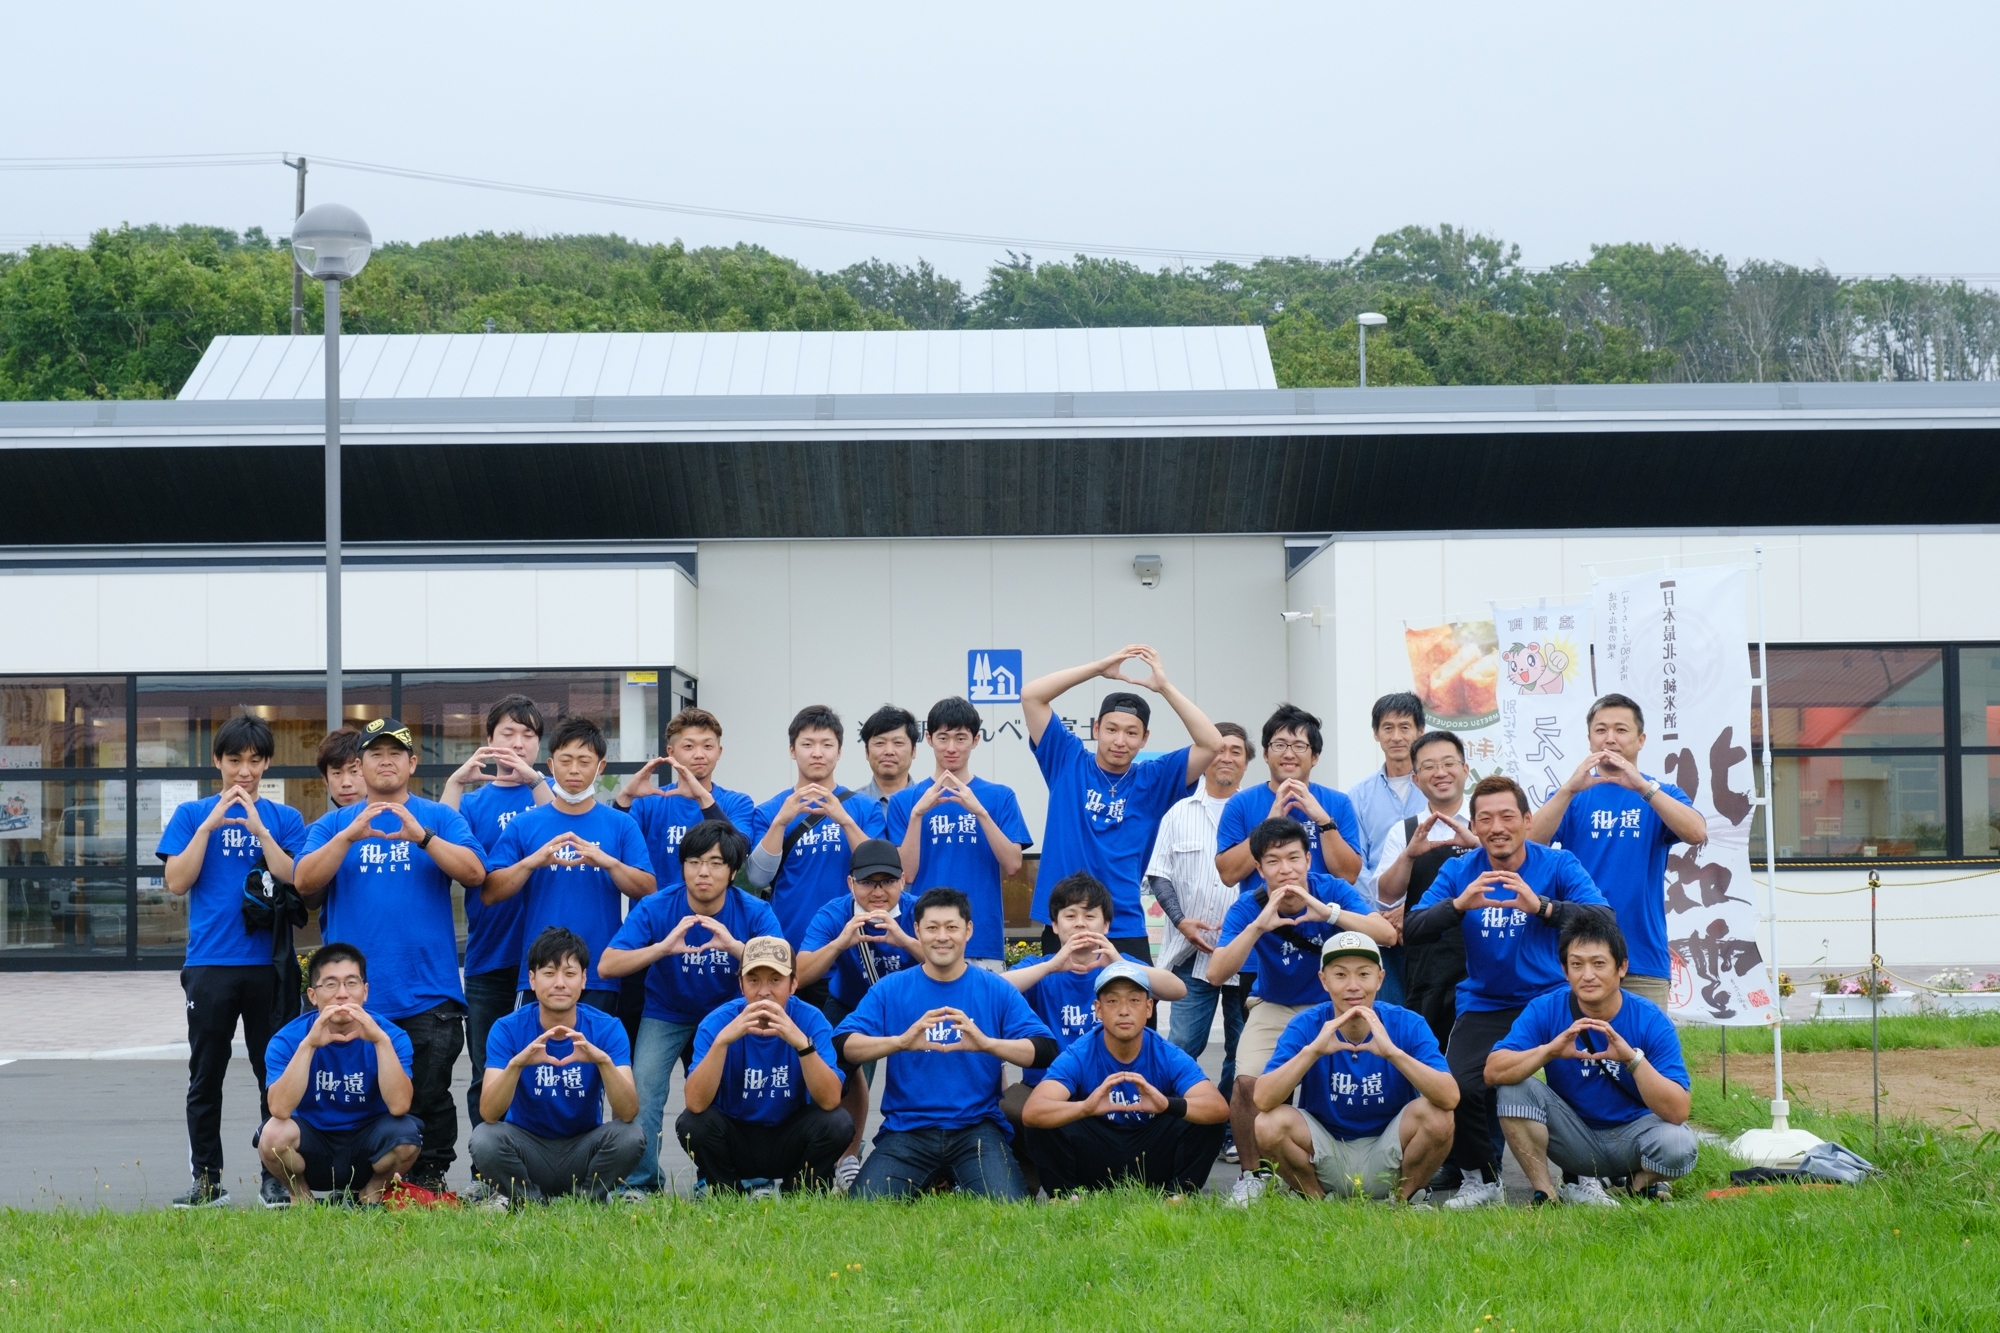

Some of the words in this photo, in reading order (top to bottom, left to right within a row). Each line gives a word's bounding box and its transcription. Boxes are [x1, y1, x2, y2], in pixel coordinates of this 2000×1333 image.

[929, 813, 977, 835] 和遠
[1591, 808, 1641, 829] 和遠
[667, 825, 687, 845] 和
[932, 835, 977, 844] WAEN
[1590, 830, 1640, 838] WAEN
[222, 849, 255, 857] WAE
[360, 841, 410, 864] 和遠
[795, 844, 841, 856] WAEN
[360, 863, 411, 873] WAEN
[1481, 929, 1516, 938] WAE
[681, 965, 731, 975] WAEN
[316, 1070, 365, 1094] 和遠
[535, 1065, 584, 1089] 和遠
[744, 1064, 790, 1089] 和遠
[1331, 1071, 1384, 1096] 和遠
[315, 1092, 366, 1103] WAEN
[534, 1088, 585, 1098] WAEN
[742, 1089, 791, 1099] WAEN
[1330, 1093, 1385, 1106] WAEN
